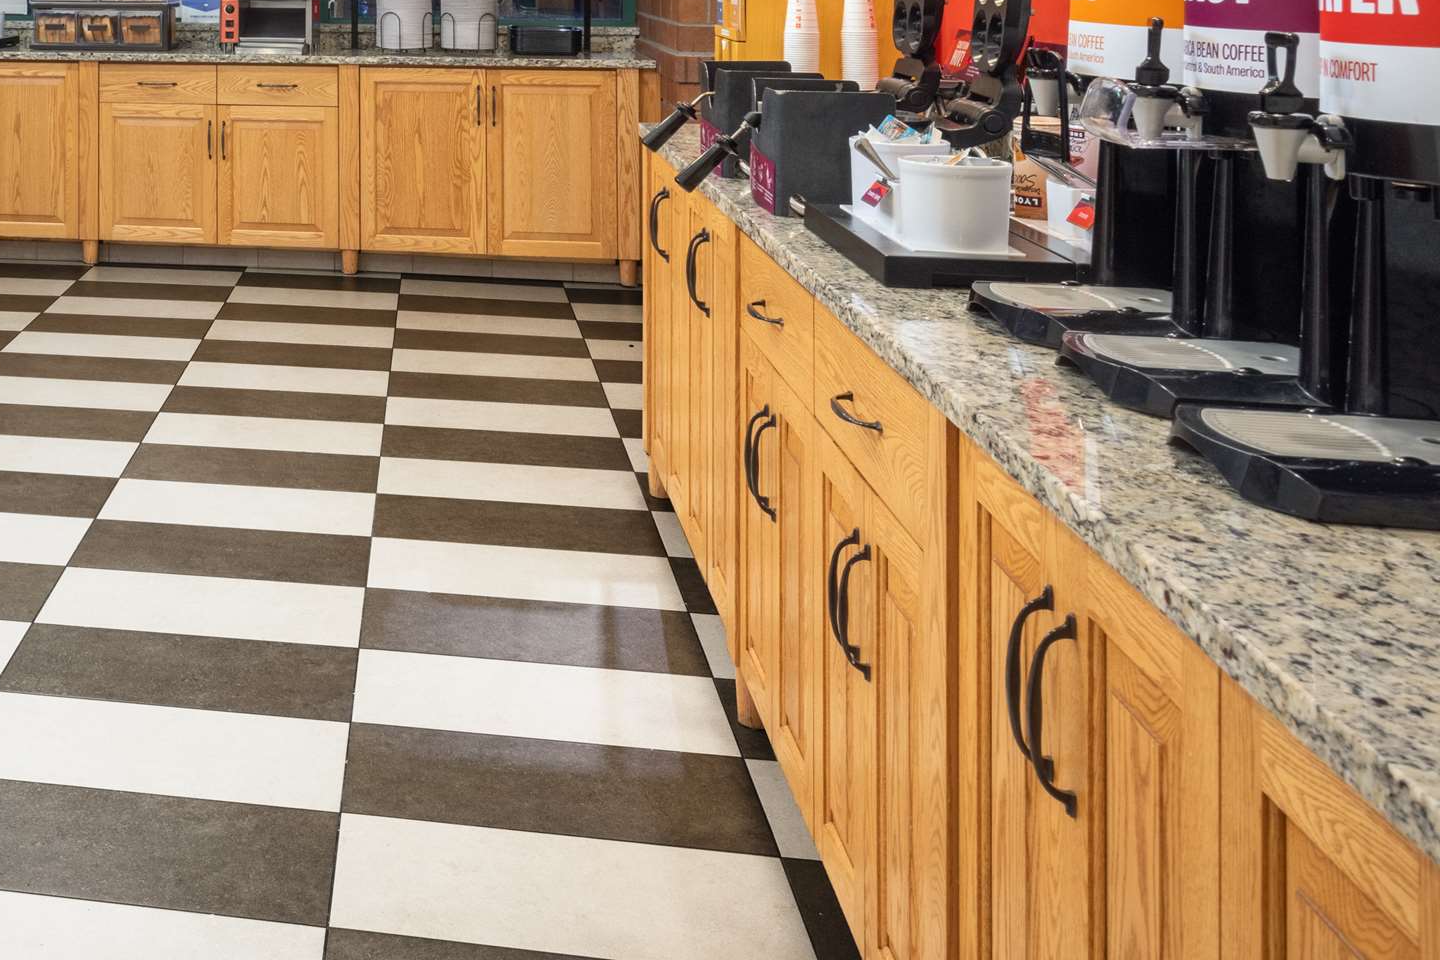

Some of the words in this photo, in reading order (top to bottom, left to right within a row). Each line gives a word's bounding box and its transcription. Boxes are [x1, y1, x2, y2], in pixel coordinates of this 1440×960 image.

[1078, 33, 1104, 50] COFFEE
[1196, 41, 1219, 58] BEAN
[1222, 43, 1265, 62] COFFEE
[1203, 62, 1225, 75] South
[1226, 65, 1265, 78] America
[1329, 59, 1378, 82] COMFORT
